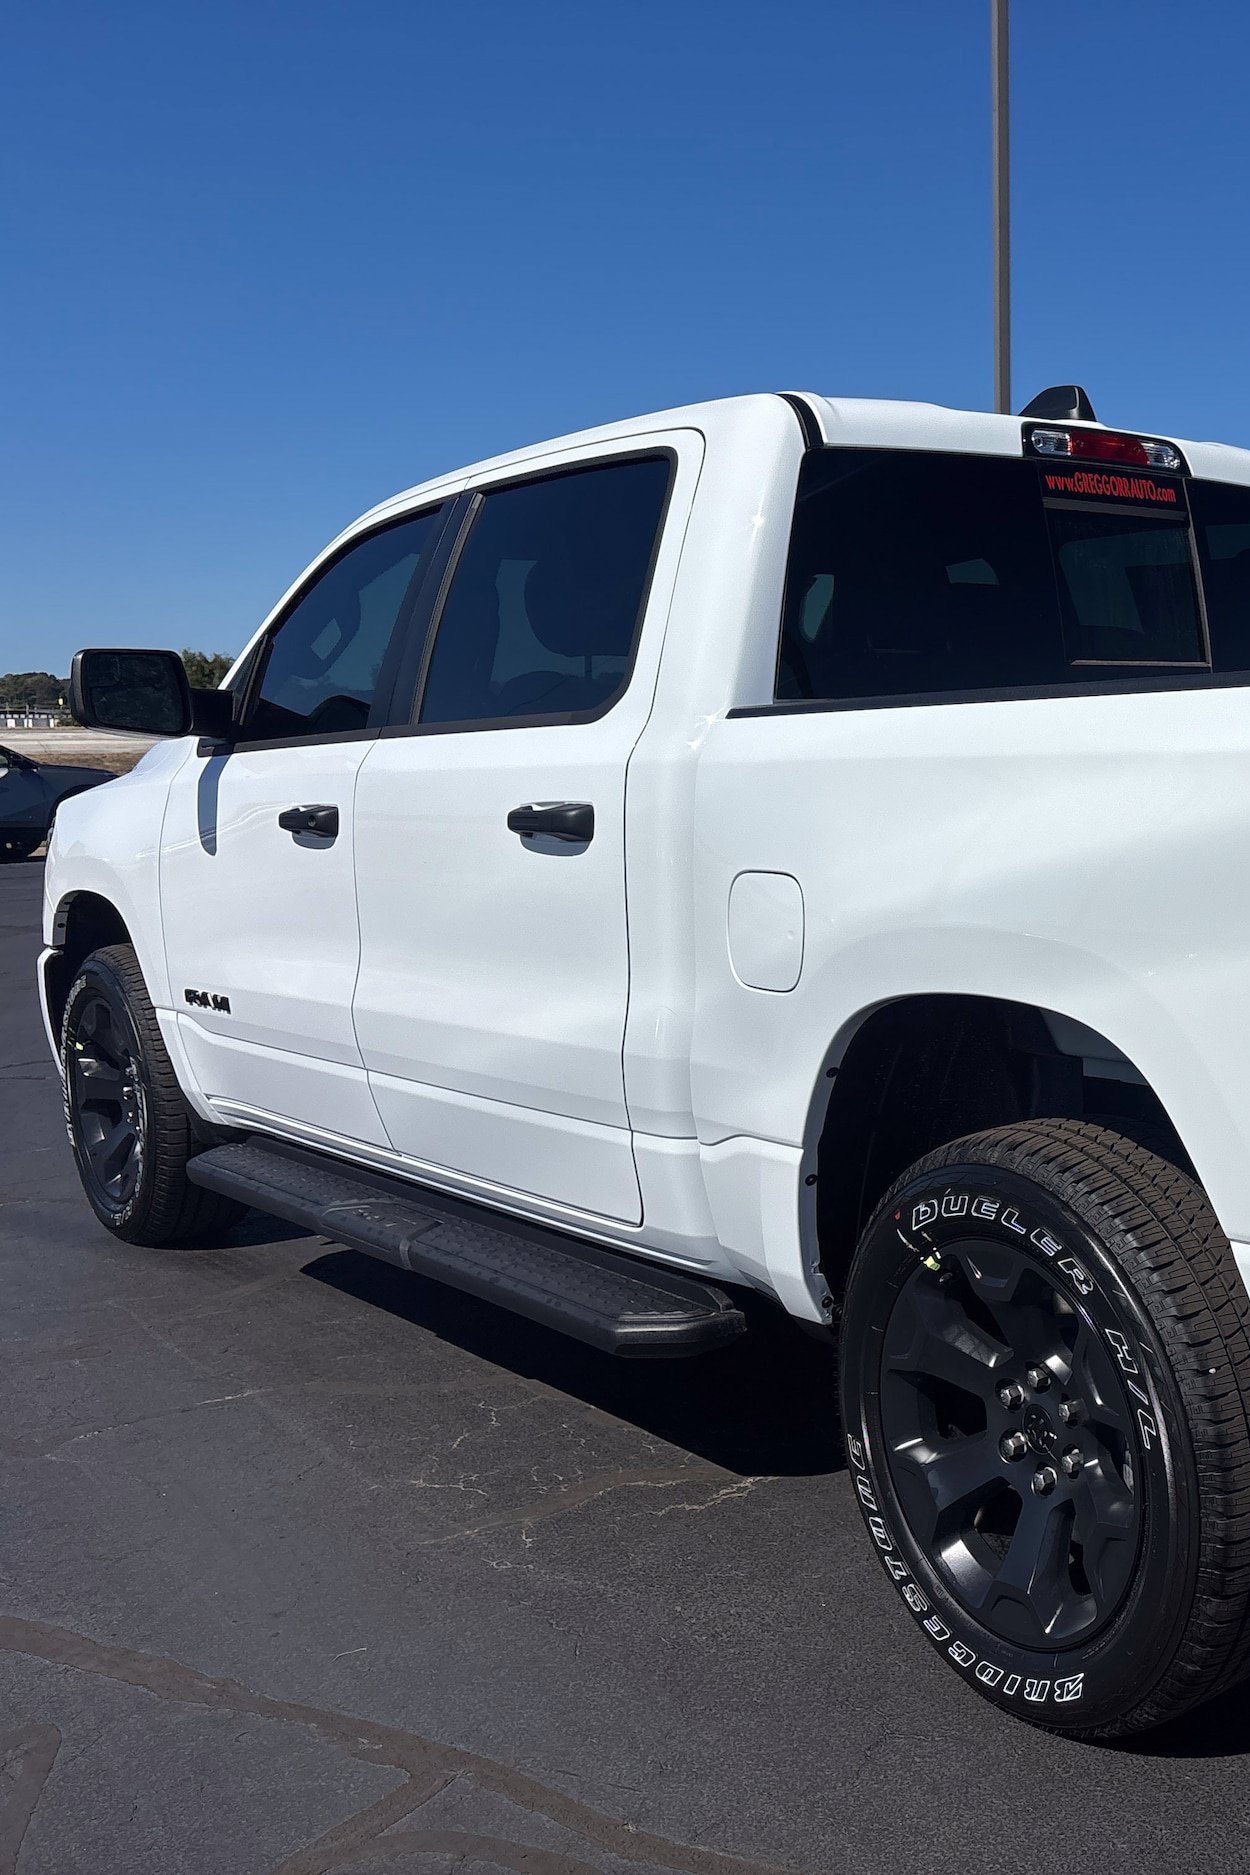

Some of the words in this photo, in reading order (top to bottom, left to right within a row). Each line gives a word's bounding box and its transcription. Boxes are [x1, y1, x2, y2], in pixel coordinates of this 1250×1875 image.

[1045, 471, 1176, 503] www.GREGGORRAUTO.com
[912, 1194, 1094, 1296] DUELER
[847, 1433, 1085, 1702] BRIDGESTONE
